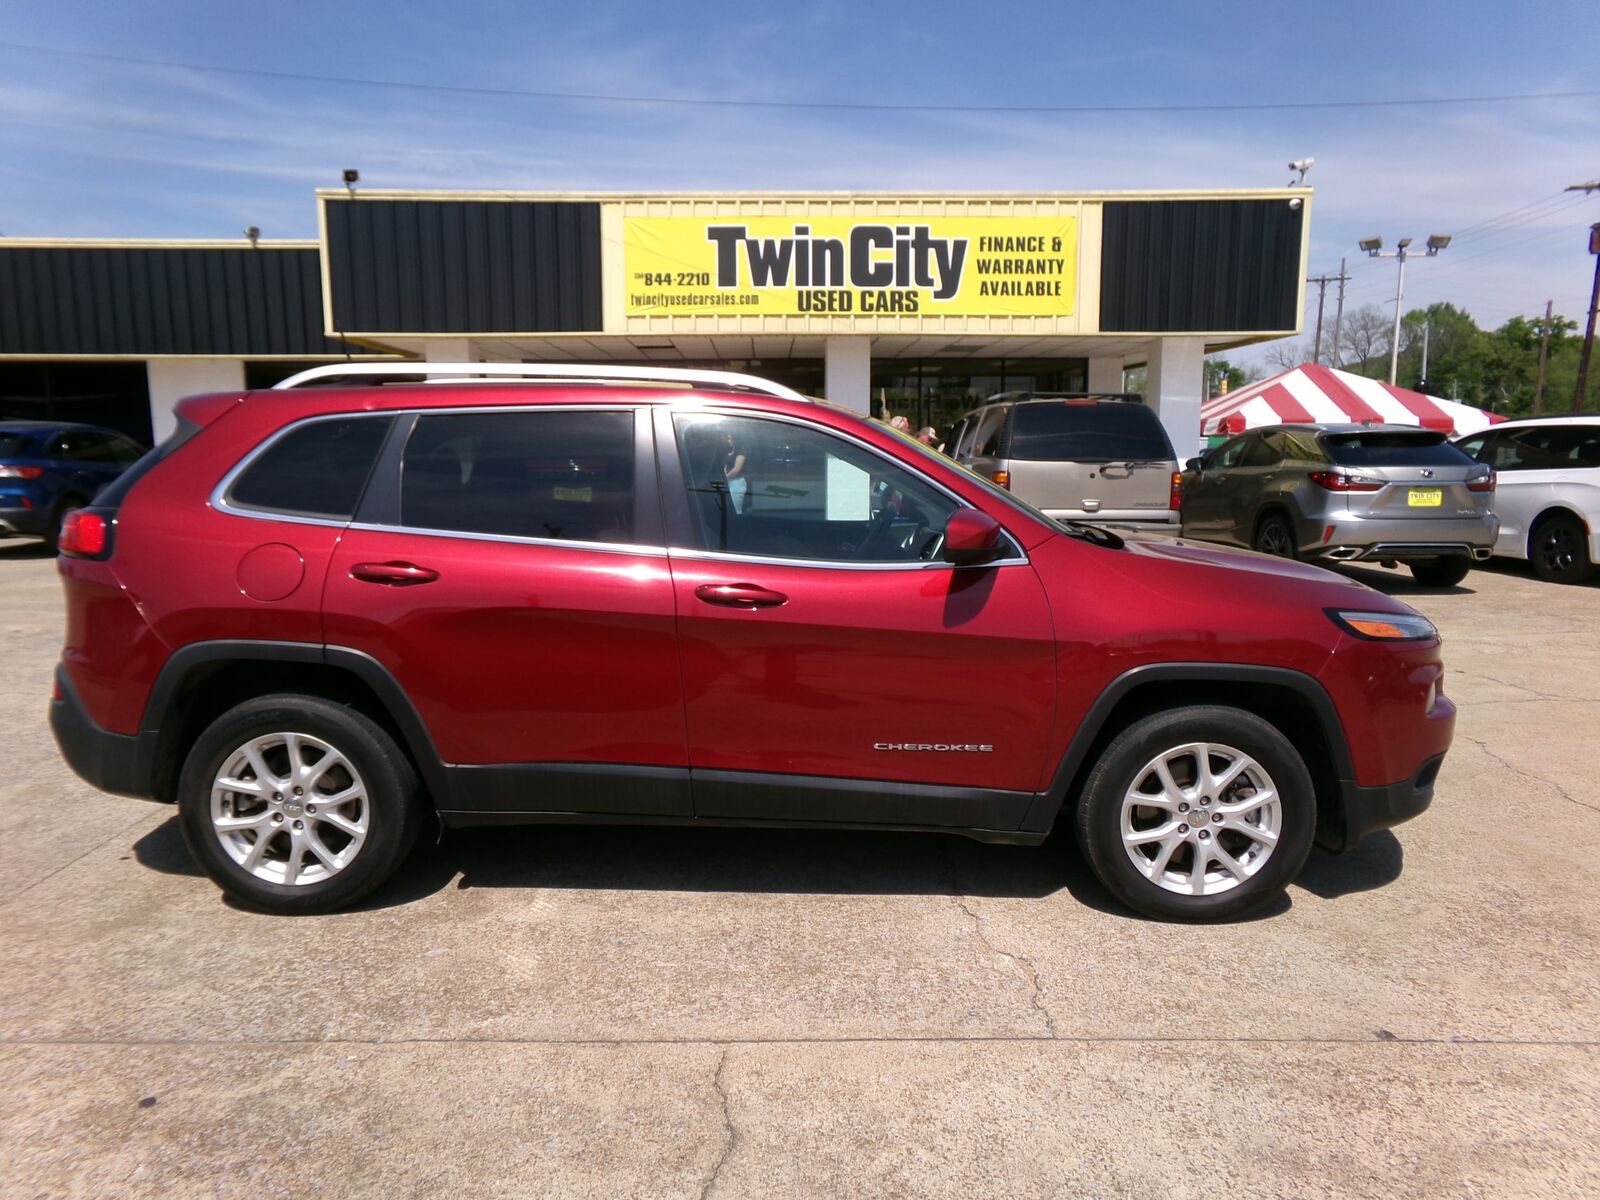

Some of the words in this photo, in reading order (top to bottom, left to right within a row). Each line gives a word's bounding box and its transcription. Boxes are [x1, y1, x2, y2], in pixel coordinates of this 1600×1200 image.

[979, 236, 1045, 253] FINANCE
[1051, 236, 1063, 252] &
[976, 258, 1065, 275] WARRANTY
[643, 272, 710, 287] 844-2210
[979, 280, 1062, 297] AVAILABLE
[630, 292, 760, 308] twincityusedcarsales.com
[797, 290, 853, 312] USED
[860, 290, 919, 313] CARS
[873, 743, 993, 752] CHEROKEE
